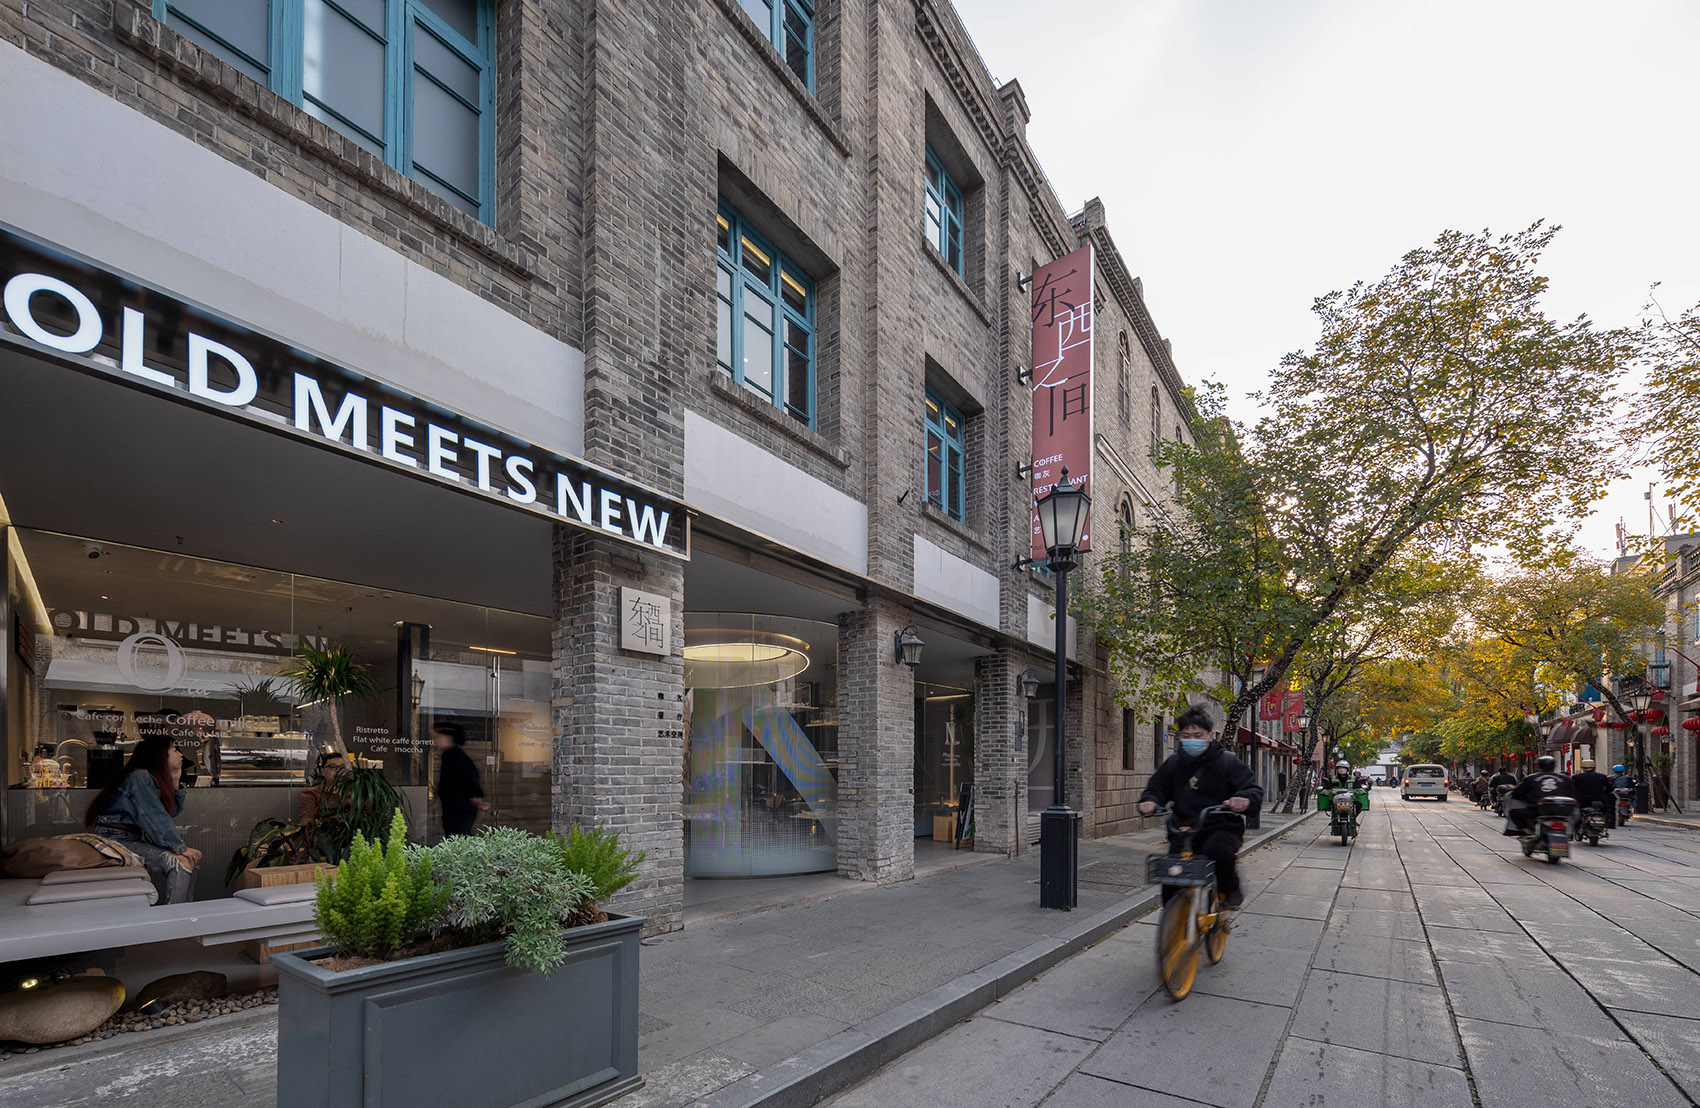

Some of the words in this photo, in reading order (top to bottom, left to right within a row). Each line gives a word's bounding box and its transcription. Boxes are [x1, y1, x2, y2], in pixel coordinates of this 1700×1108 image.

[4, 272, 258, 407] OLD
[294, 372, 536, 504] MEETS
[556, 472, 669, 548] NEW
[1033, 453, 1063, 468] COFFEE
[1033, 474, 1088, 495] RESTAANT
[105, 713, 127, 723] con
[130, 713, 163, 725] Leche
[165, 713, 216, 727] Coffee
[218, 716, 251, 730] milk
[101, 724, 127, 736] Kopi
[133, 726, 169, 737] Luwak
[356, 726, 389, 735] Ristretto
[172, 739, 201, 749] ccino
[352, 735, 368, 743] Flat
[368, 736, 391, 744] white
[394, 745, 424, 754] moccha
